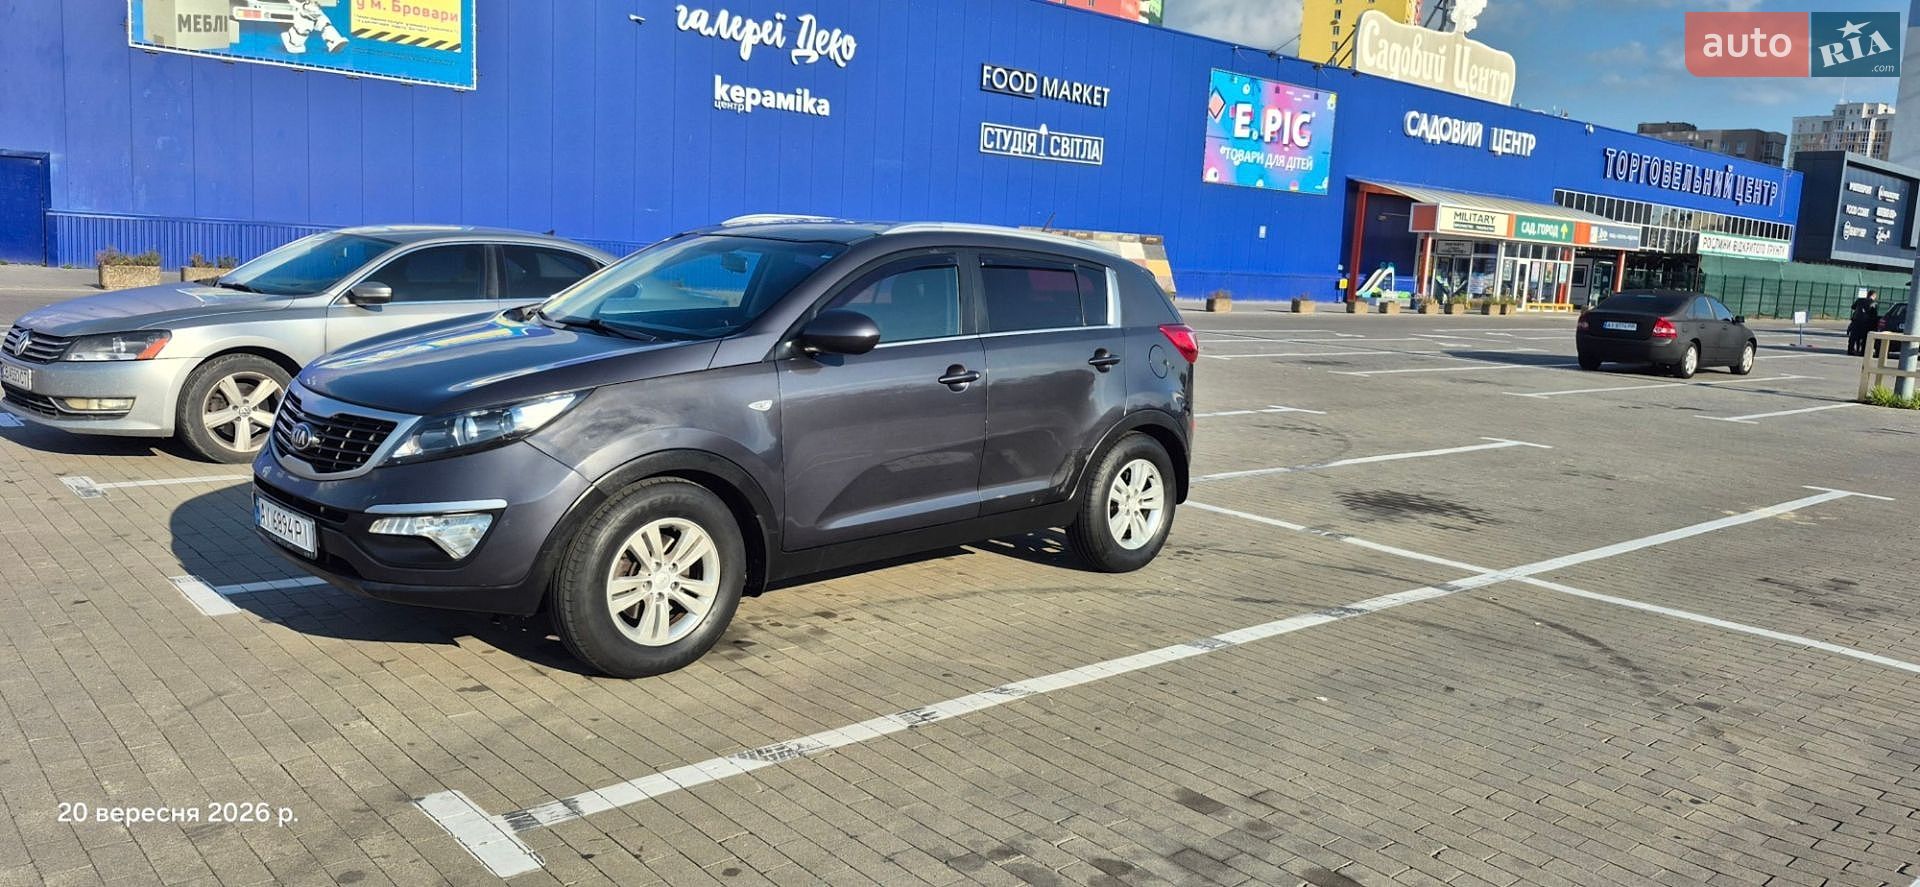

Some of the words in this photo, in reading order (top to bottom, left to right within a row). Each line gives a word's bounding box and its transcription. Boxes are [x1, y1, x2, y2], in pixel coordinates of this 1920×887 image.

[177, 13, 229, 33] МЕБЛІ
[392, 0, 458, 22] Бровари
[676, 5, 786, 61] галереї
[790, 14, 857, 67] Деко
[1363, 20, 1447, 84] Садовий
[1454, 44, 1511, 101] Центр
[981, 64, 1037, 95] FOOD
[1041, 77, 1110, 108] MARKET
[983, 127, 1036, 156] СТУДІЯ
[1049, 132, 1101, 162] СВІТЛА
[1403, 111, 1482, 147] САДОВИЙ
[1490, 127, 1536, 157] ЦЕНТР
[1264, 153, 1285, 168] ДЛЯ
[1285, 155, 1313, 172] ДІТЕЙ
[1605, 147, 1733, 200] ТОРГОВЕЛЬНИЙ
[1735, 174, 1779, 206] ЦЕНТР
[1453, 211, 1496, 225] MILITARY
[1537, 223, 1559, 237] ГОРОД
